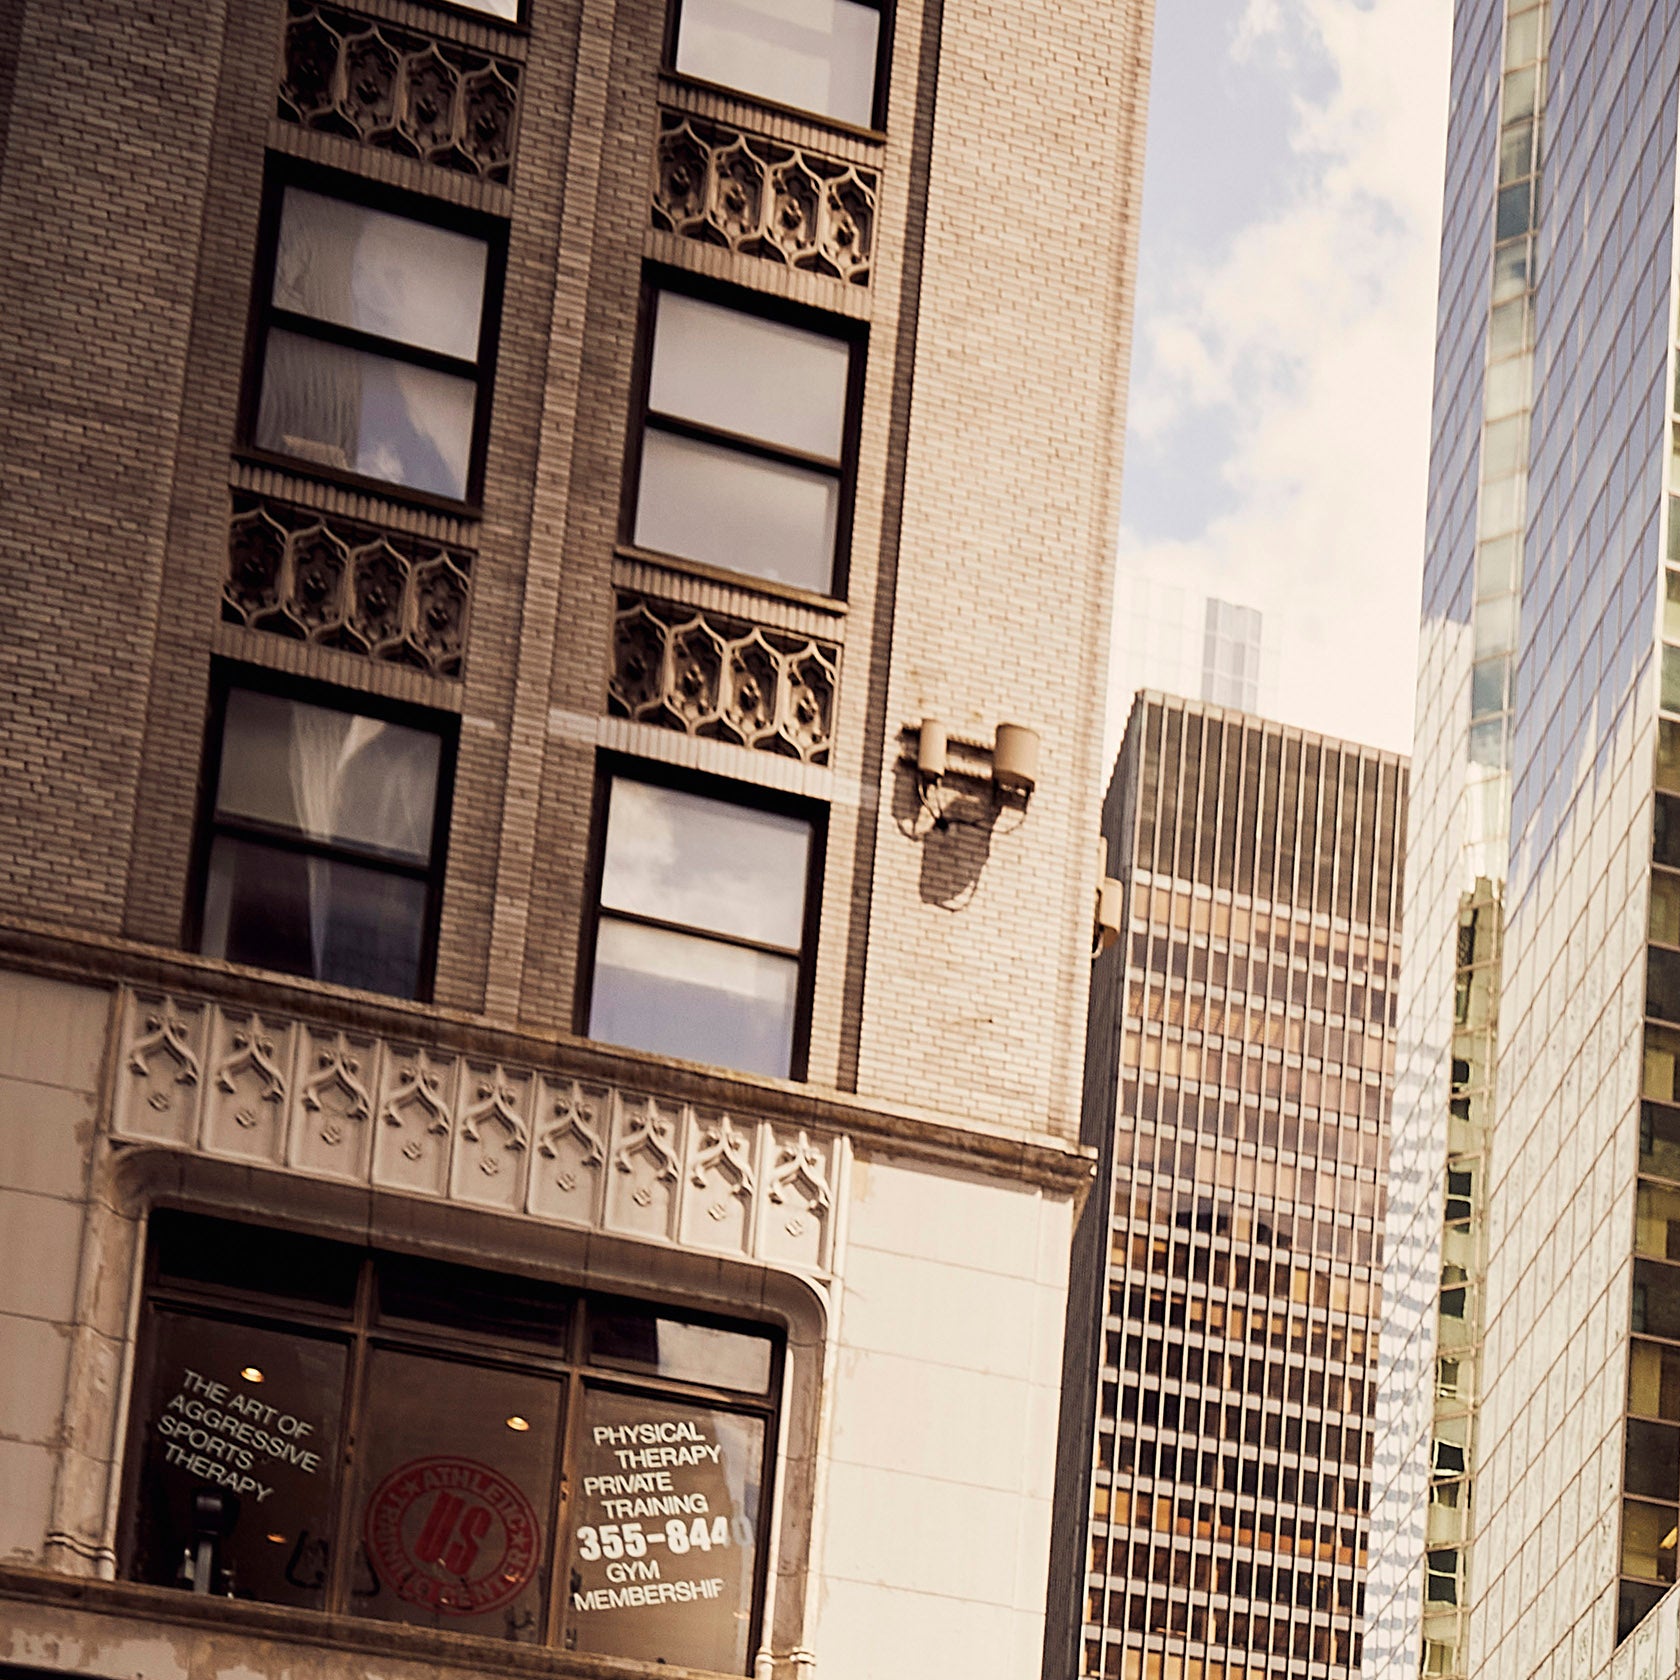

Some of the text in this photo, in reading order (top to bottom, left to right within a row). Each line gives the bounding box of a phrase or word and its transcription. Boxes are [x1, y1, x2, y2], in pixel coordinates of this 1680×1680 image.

[182, 1368, 314, 1439] THE ART OF
[158, 1415, 254, 1470] SPORTS
[168, 1394, 320, 1473] AGGRESSIVE
[593, 1422, 706, 1446] PHYSICAL
[165, 1442, 274, 1502] THERAPY
[614, 1445, 722, 1469] THERAPY
[422, 1466, 527, 1530] ATHLETIC
[584, 1472, 674, 1496] PRIVATE
[601, 1494, 709, 1519] TRAINING
[606, 1560, 661, 1583] GYM
[574, 1579, 724, 1611] MEMBERSHIP
